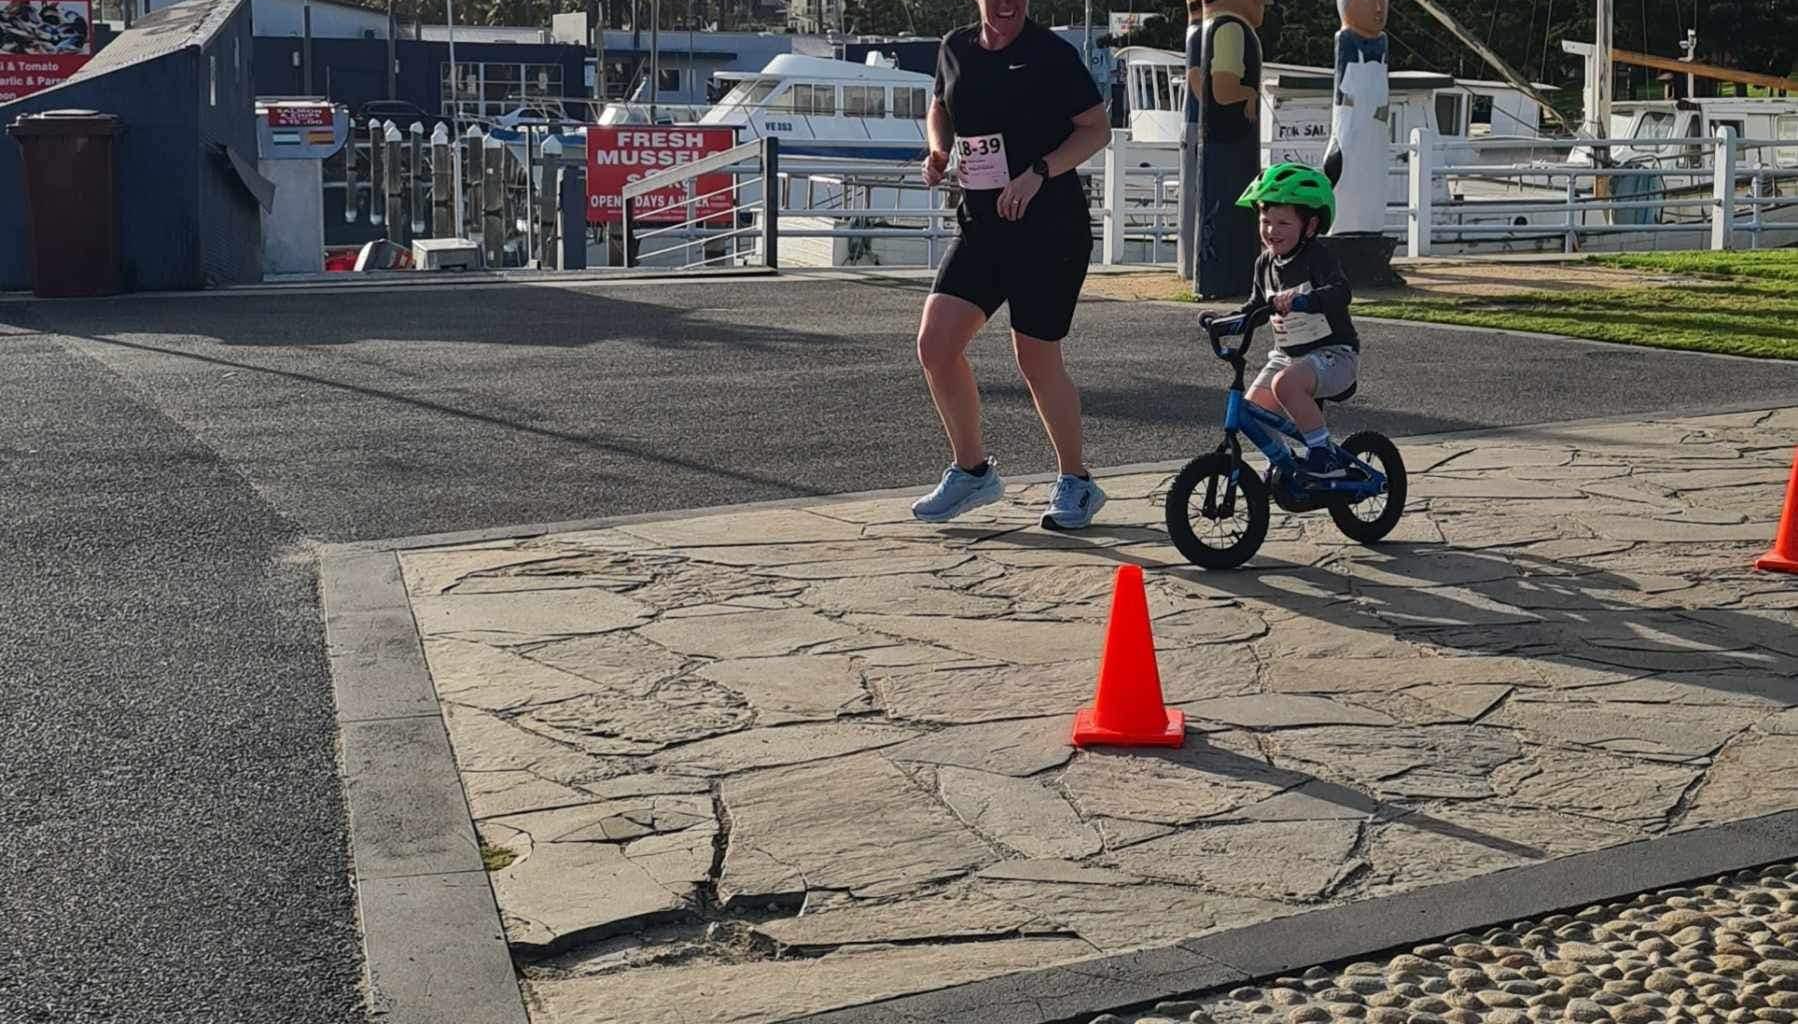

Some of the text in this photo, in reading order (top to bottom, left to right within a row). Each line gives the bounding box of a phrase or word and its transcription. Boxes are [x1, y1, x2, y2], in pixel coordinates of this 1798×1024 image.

[7, 61, 15, 71] &
[18, 61, 59, 71] Tomato
[26, 76, 34, 86] &
[617, 132, 704, 147] FRESH
[591, 195, 622, 207] OPEN
[634, 195, 665, 207] DAYS
